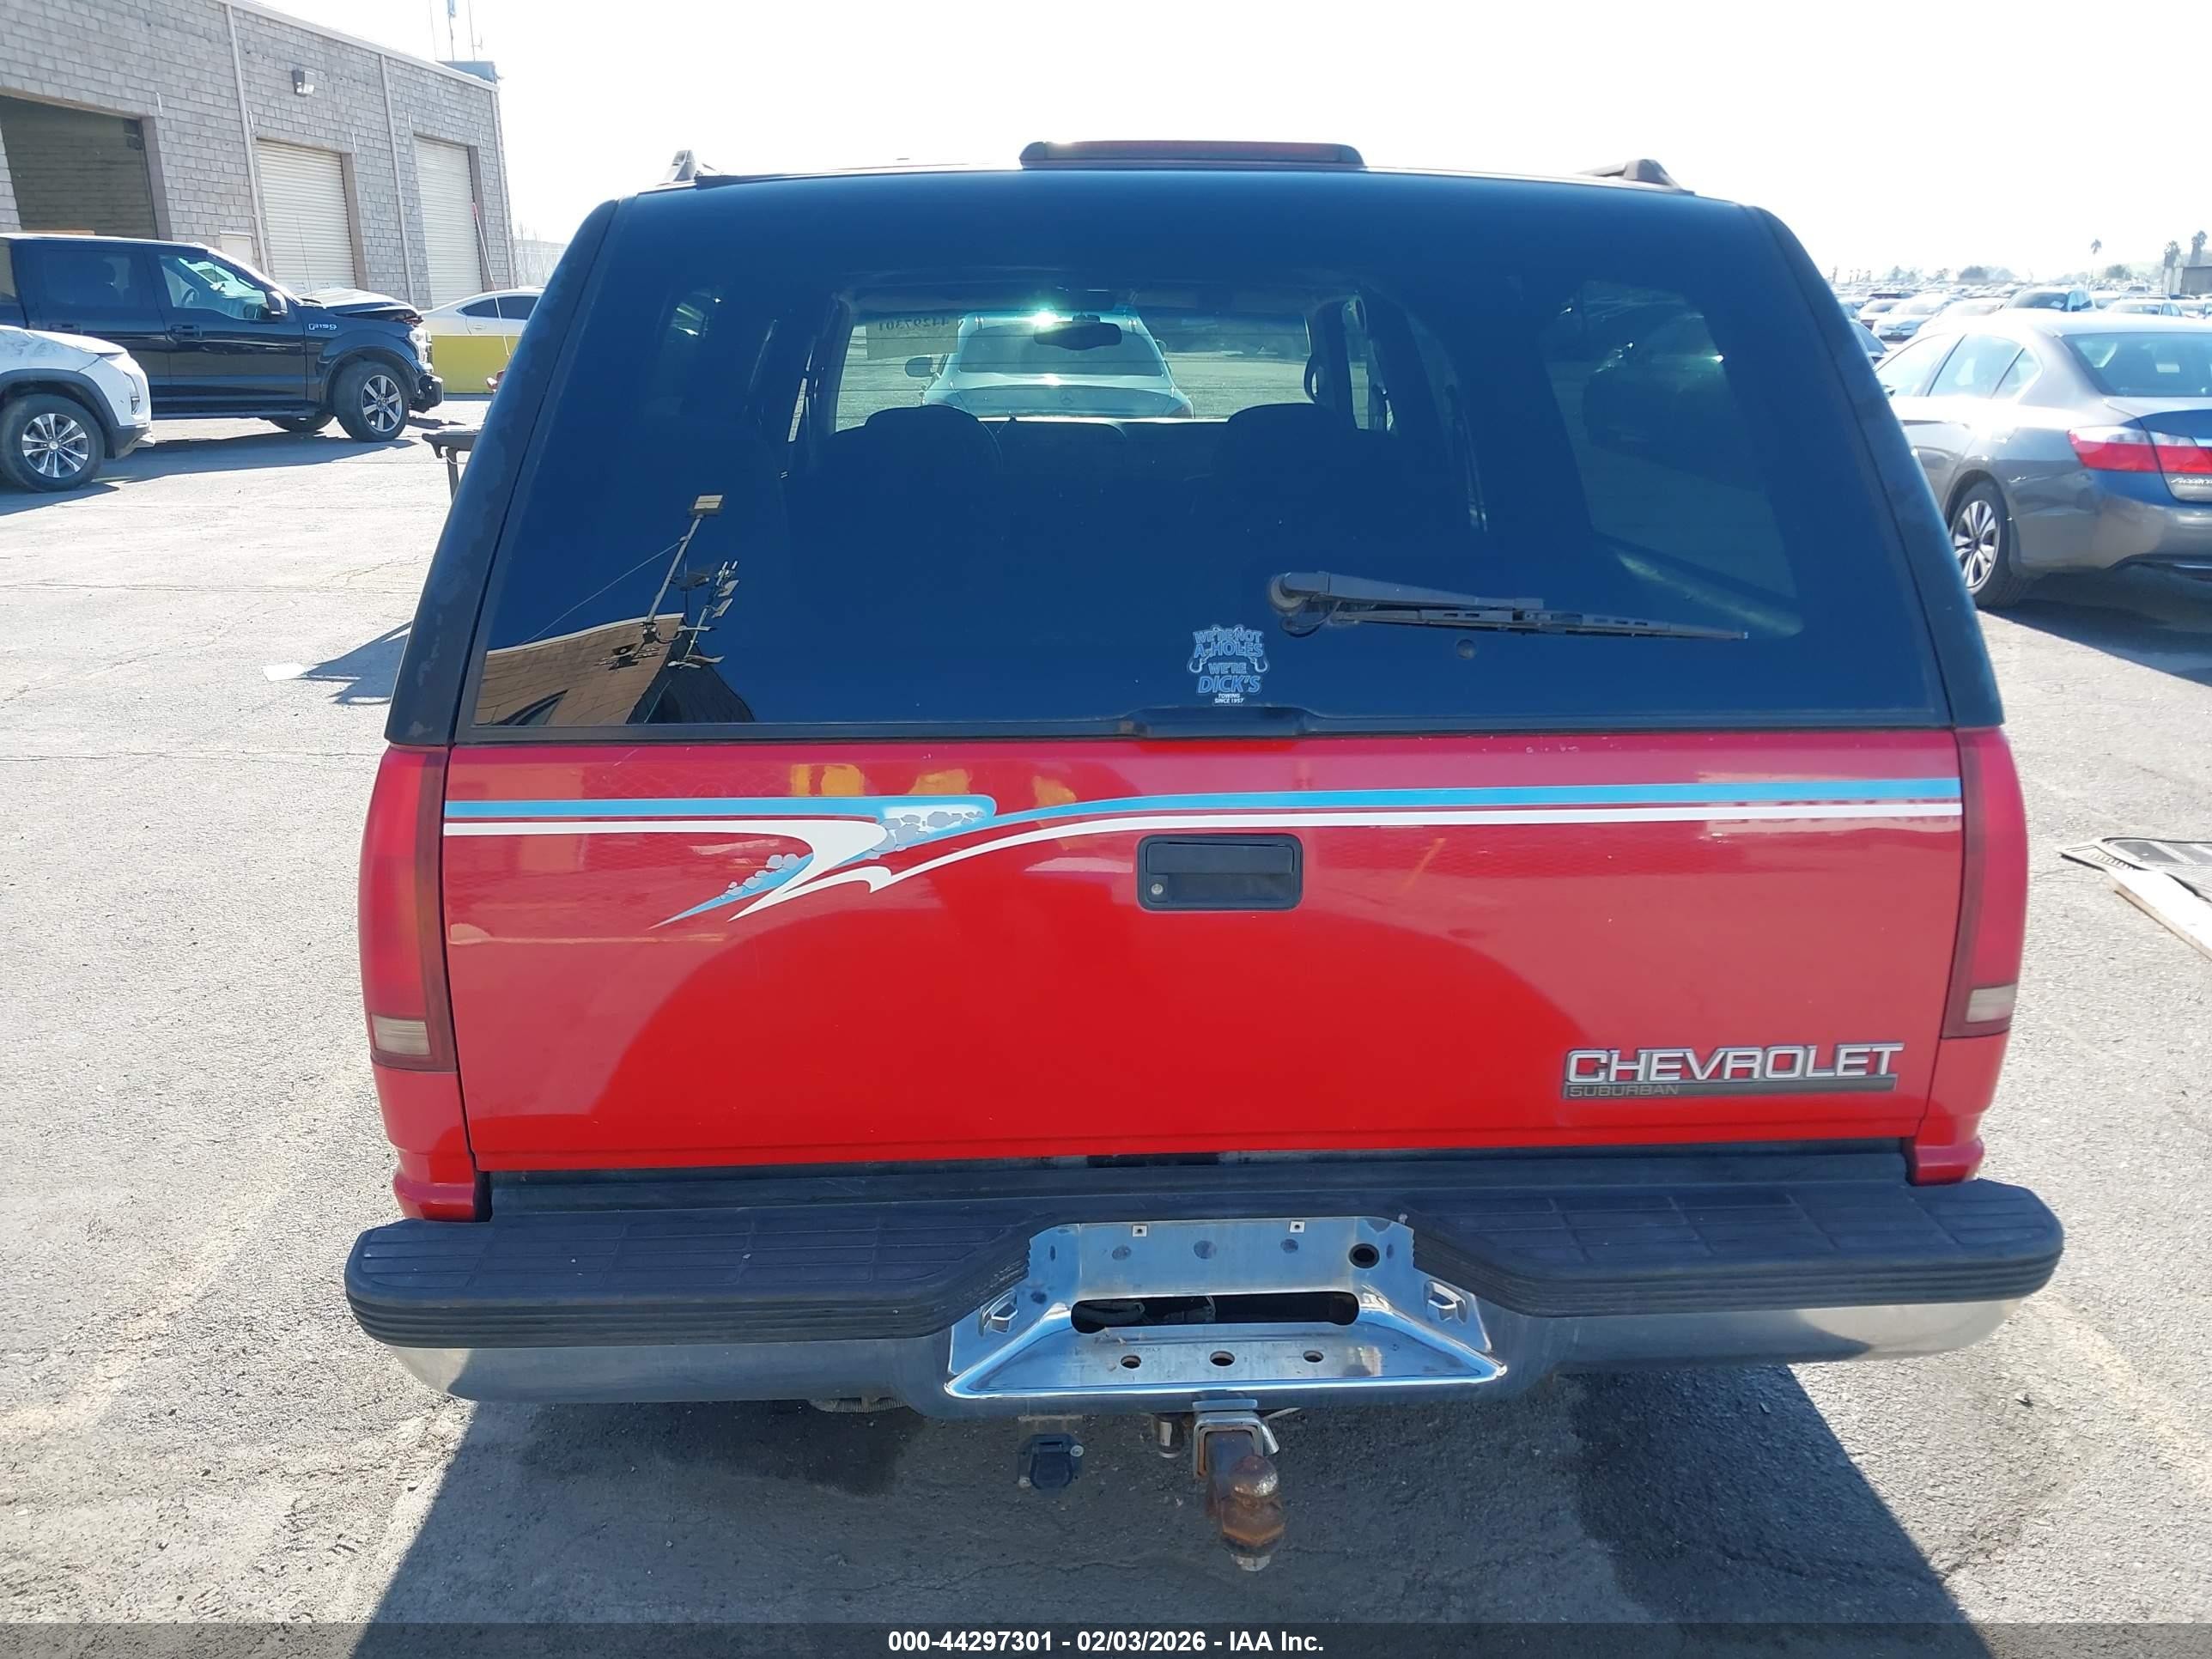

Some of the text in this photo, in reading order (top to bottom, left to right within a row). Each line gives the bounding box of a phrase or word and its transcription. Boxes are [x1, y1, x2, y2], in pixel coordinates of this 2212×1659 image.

[1193, 630, 1263, 643] WE'RE NOT
[1208, 662, 1247, 674] WE'RE
[1198, 675, 1261, 693] DICK'S
[1567, 1042, 1905, 1084] CHEVROLET
[1568, 1084, 1680, 1098] SUBURBAN
